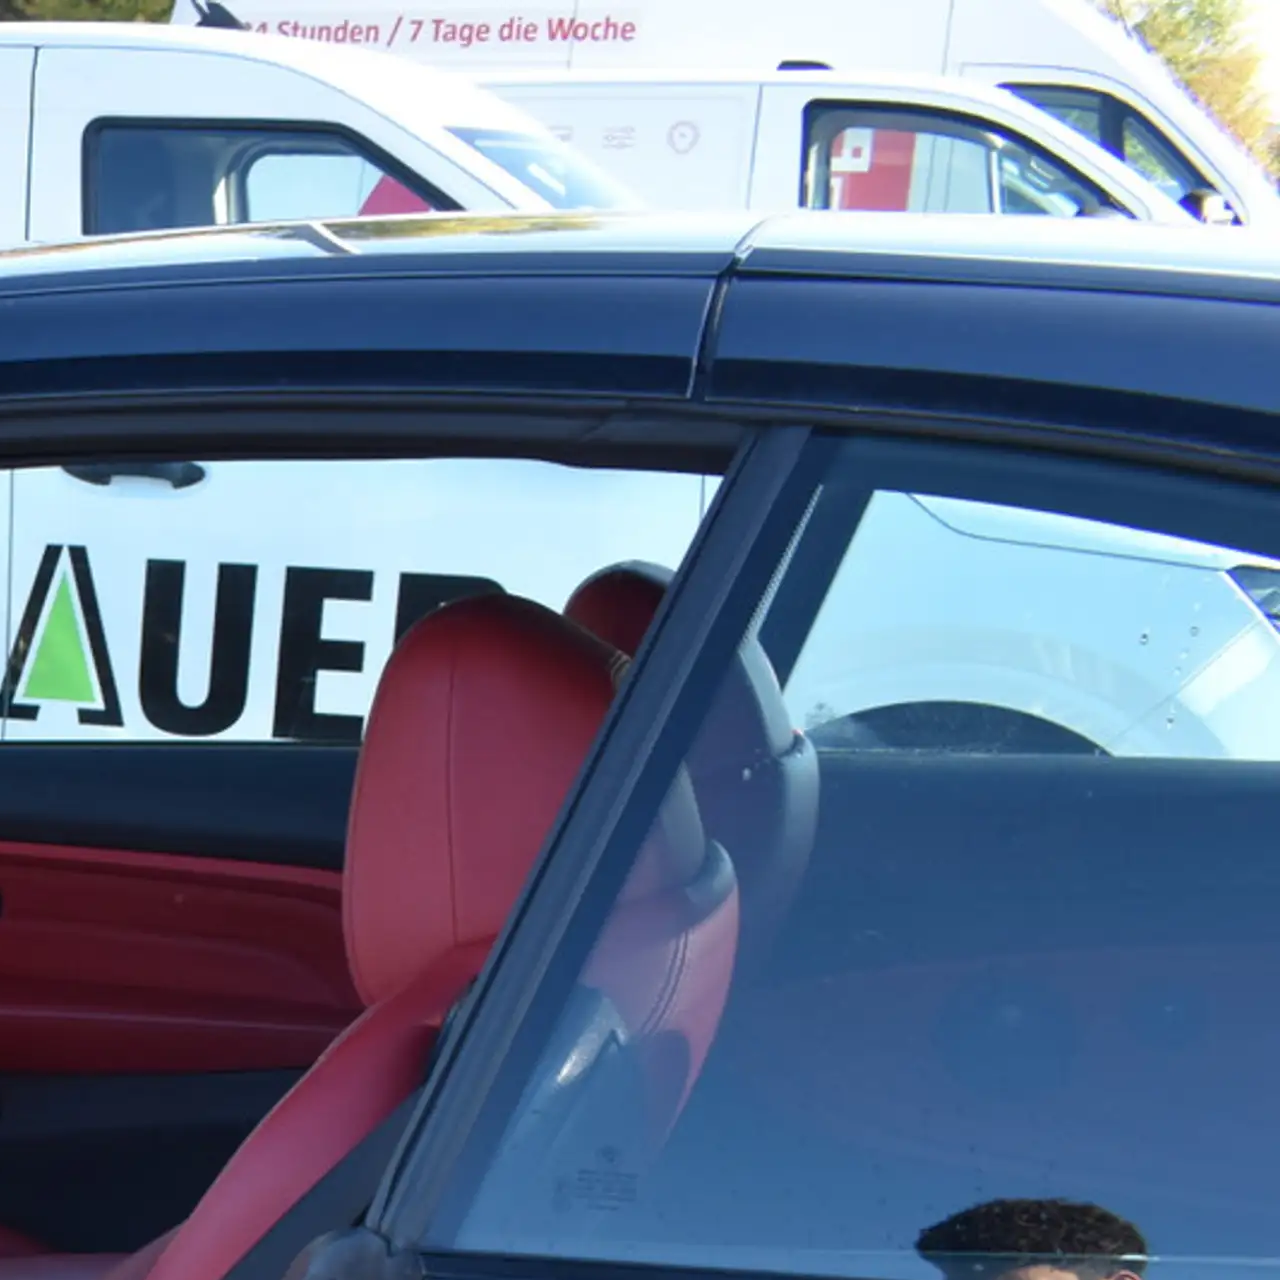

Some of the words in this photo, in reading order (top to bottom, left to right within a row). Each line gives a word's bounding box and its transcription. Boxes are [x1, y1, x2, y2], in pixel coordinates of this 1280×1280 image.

[277, 19, 380, 44] Stunden
[386, 15, 403, 48] /
[409, 19, 424, 42] 7
[431, 18, 491, 48] Tage
[498, 16, 539, 42] die
[547, 15, 637, 42] Woche
